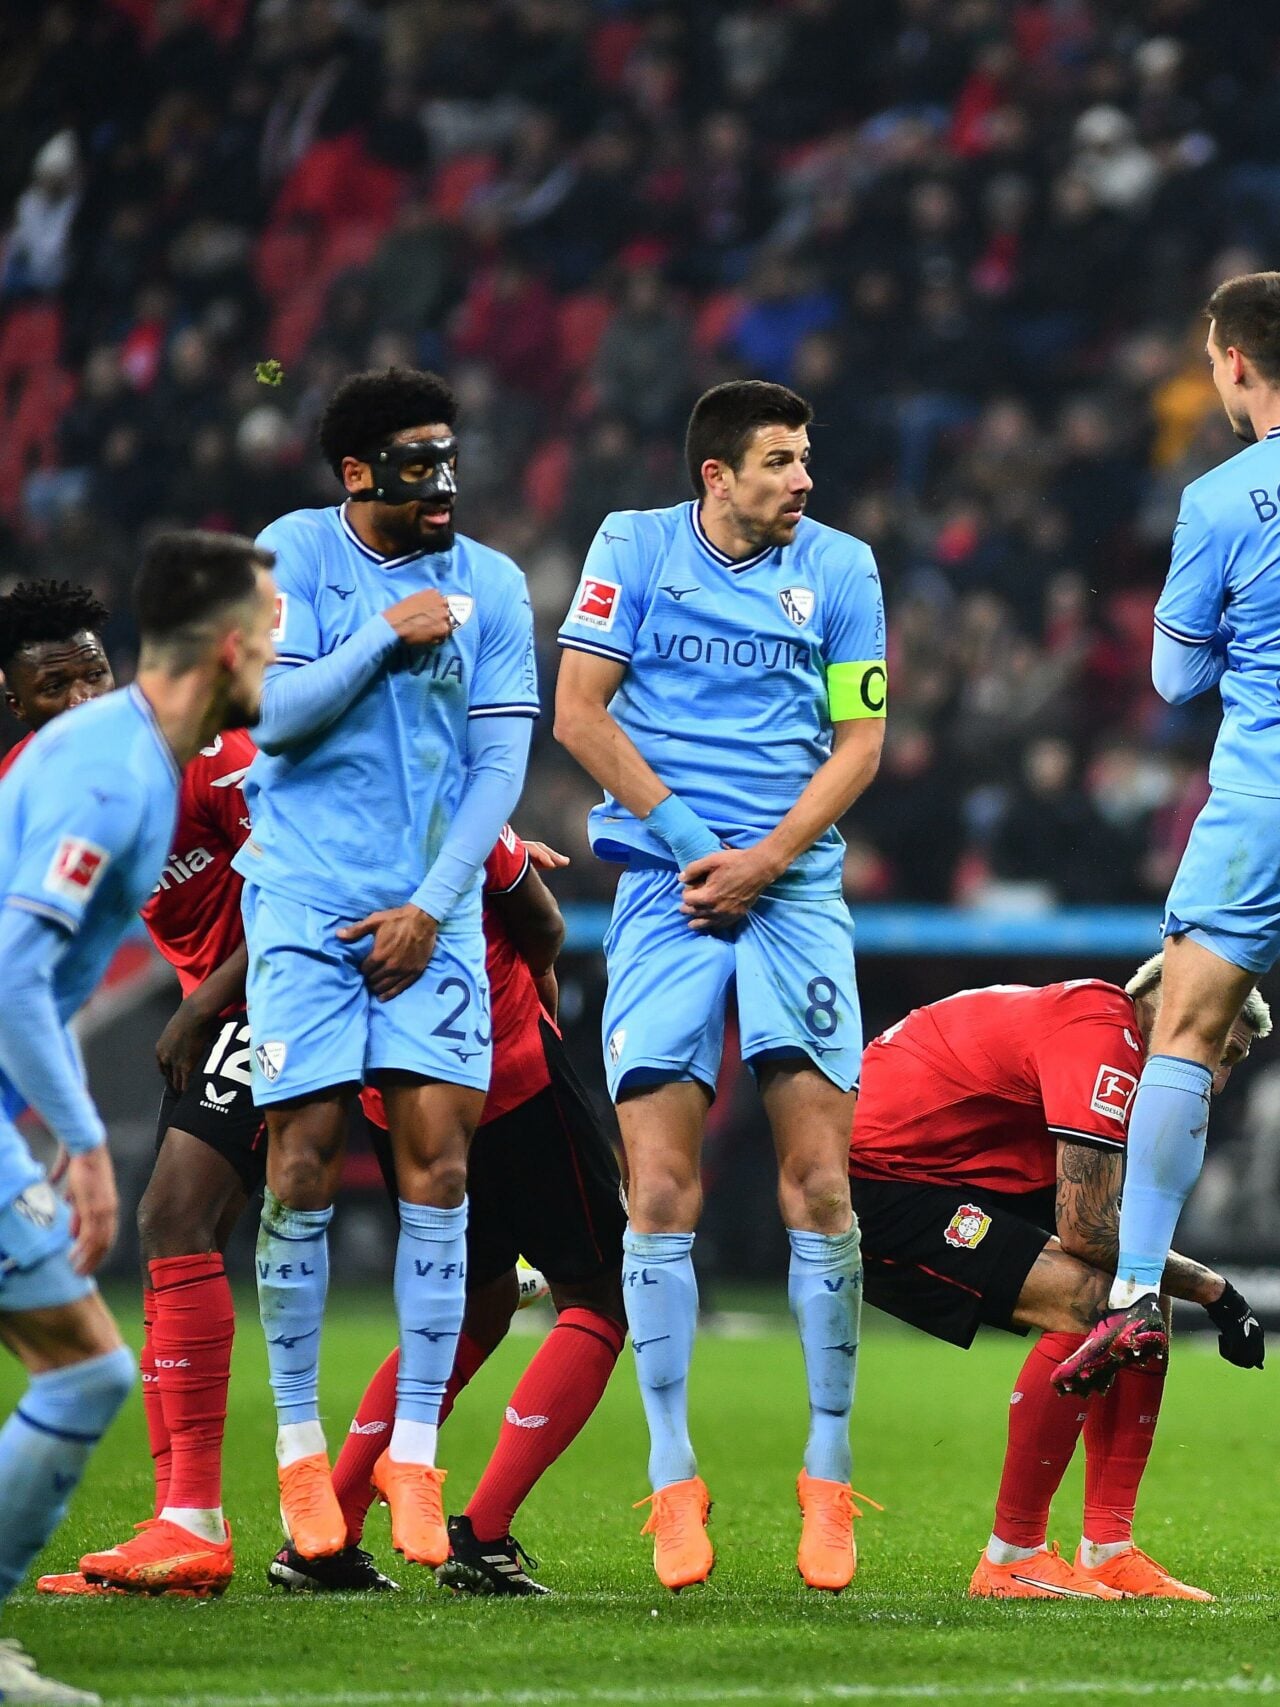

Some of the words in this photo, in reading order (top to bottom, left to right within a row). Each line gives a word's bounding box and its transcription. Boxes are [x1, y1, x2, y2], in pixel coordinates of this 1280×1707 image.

[860, 666, 886, 712] C
[151, 846, 214, 893] nia
[804, 976, 838, 1037] 8
[258, 1260, 314, 1280] VfL
[519, 1279, 537, 1294] AR
